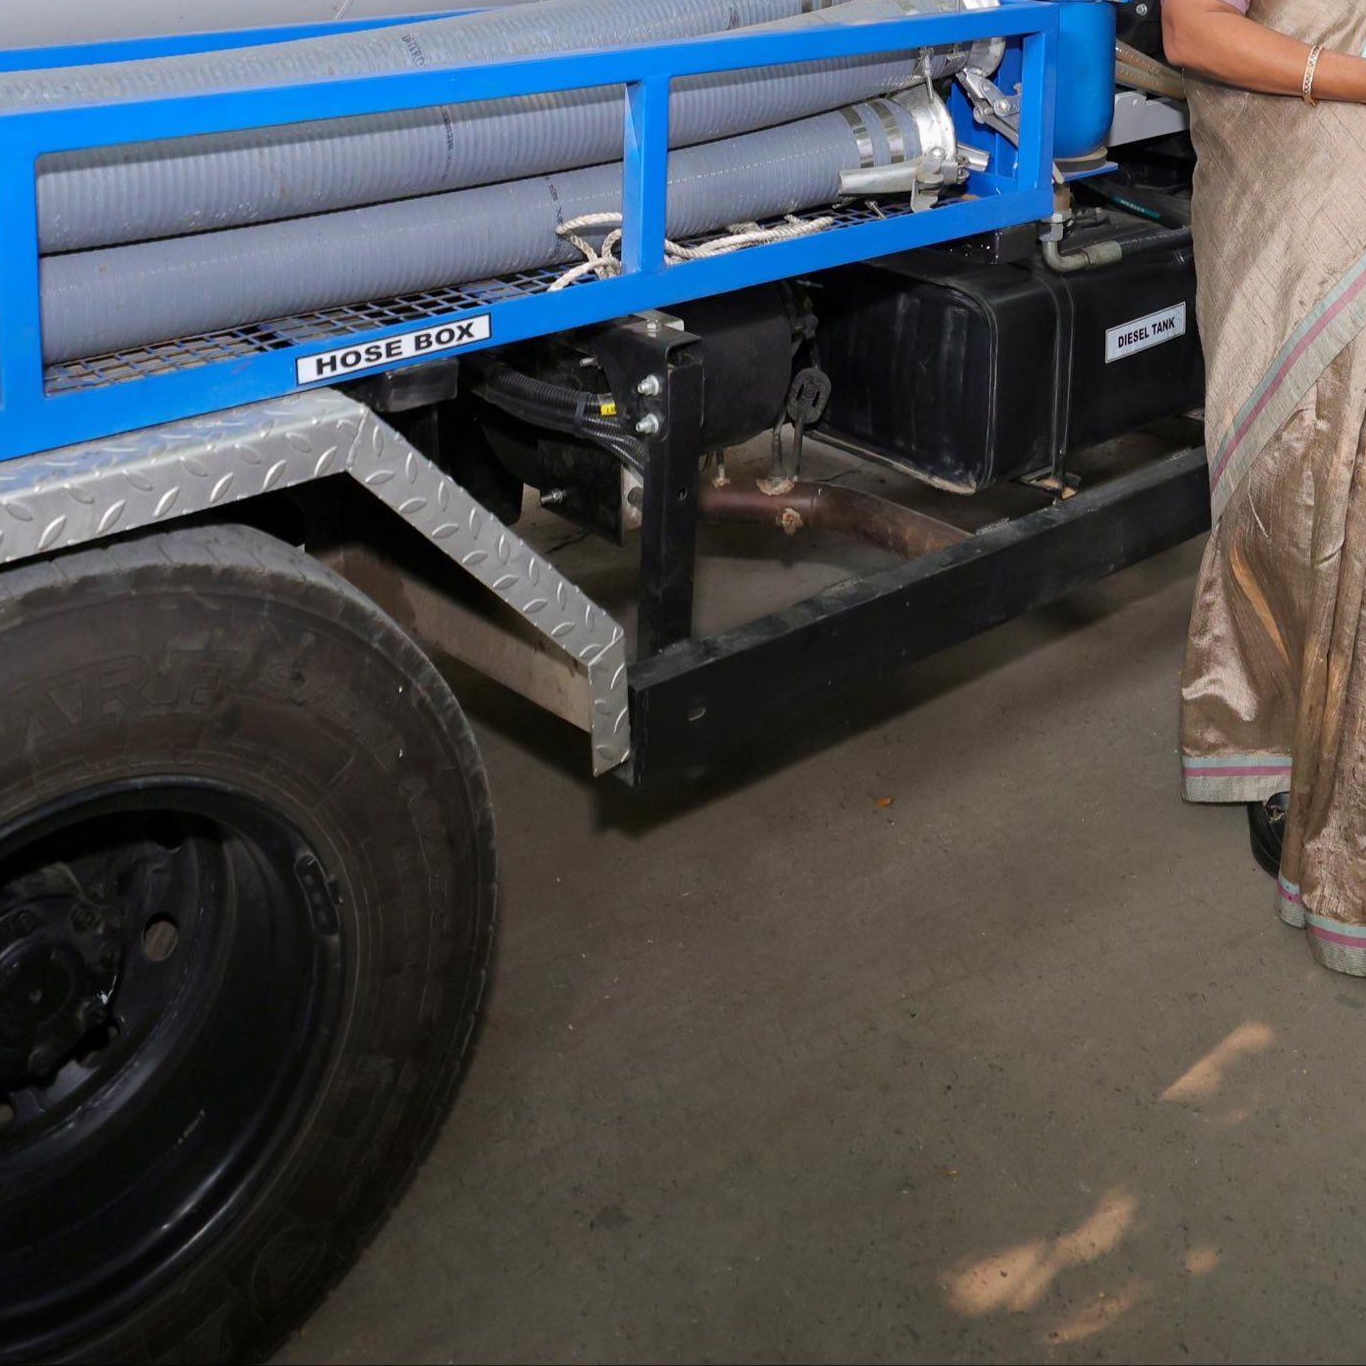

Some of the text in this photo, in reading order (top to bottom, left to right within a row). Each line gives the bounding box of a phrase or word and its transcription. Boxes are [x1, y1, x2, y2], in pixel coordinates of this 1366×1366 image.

[402, 35, 428, 67] DUTRO
[315, 321, 475, 376] HOSE BOX
[1117, 317, 1175, 349] DIESEL TANK
